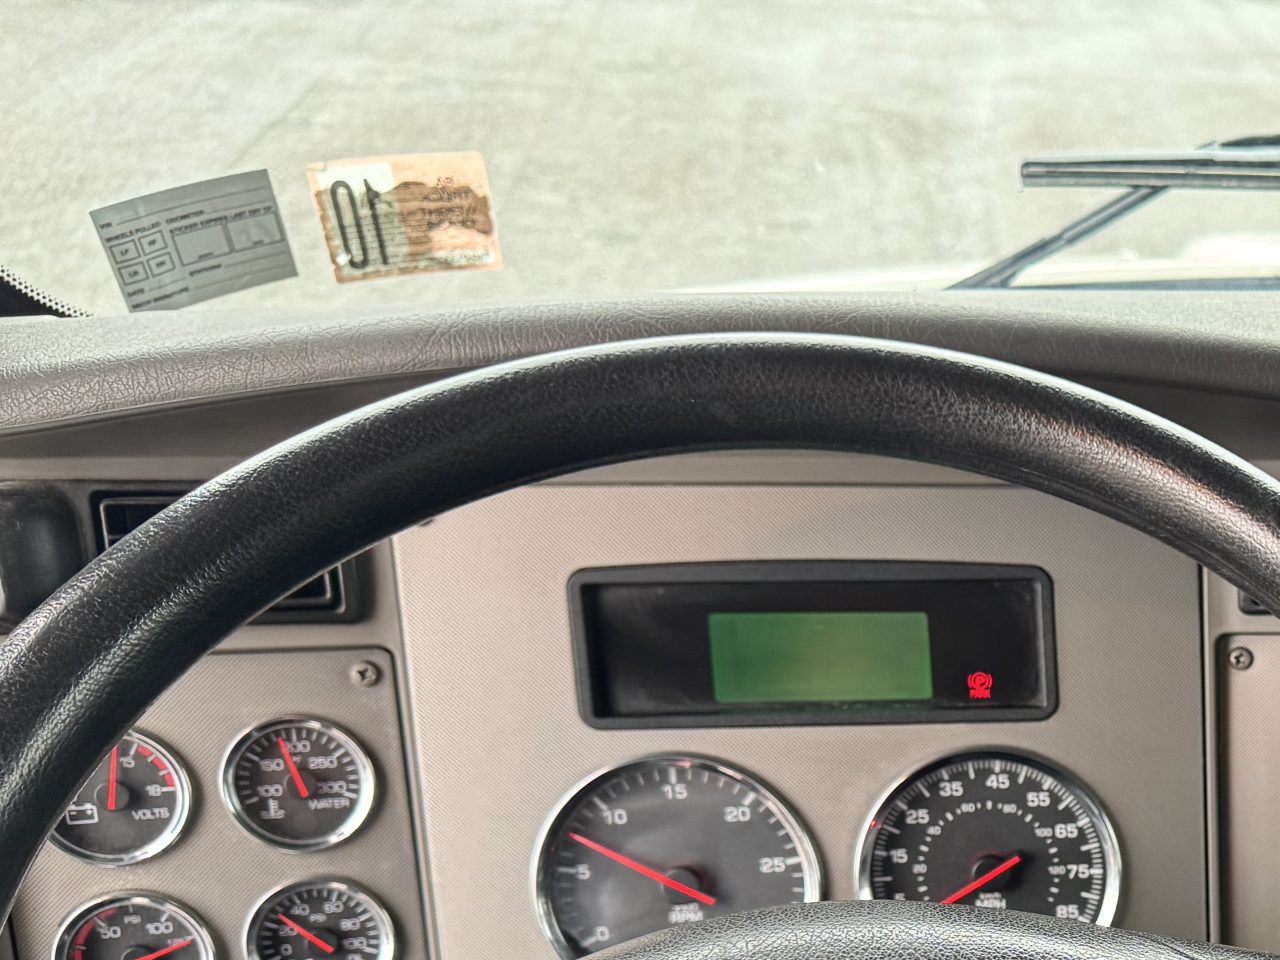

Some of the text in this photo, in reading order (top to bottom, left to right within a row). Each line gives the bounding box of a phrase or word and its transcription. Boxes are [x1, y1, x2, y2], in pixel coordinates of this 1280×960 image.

[938, 781, 964, 797] 35
[985, 773, 1010, 790] 45
[662, 784, 688, 800] 15
[1026, 791, 1051, 807] 55
[308, 797, 350, 810] WATER
[131, 807, 170, 820] VOLTS
[602, 808, 628, 825] 10
[723, 806, 751, 823] 20
[904, 809, 930, 825] 25
[1034, 826, 1053, 838] 100
[1054, 823, 1079, 839] 65
[889, 848, 909, 864] 15
[575, 864, 591, 880] 5
[758, 857, 787, 873] 25
[1066, 864, 1090, 880] 75
[667, 909, 704, 924] RPM
[1055, 904, 1080, 921] 85
[145, 921, 174, 935] 100
[596, 925, 610, 941] 0
